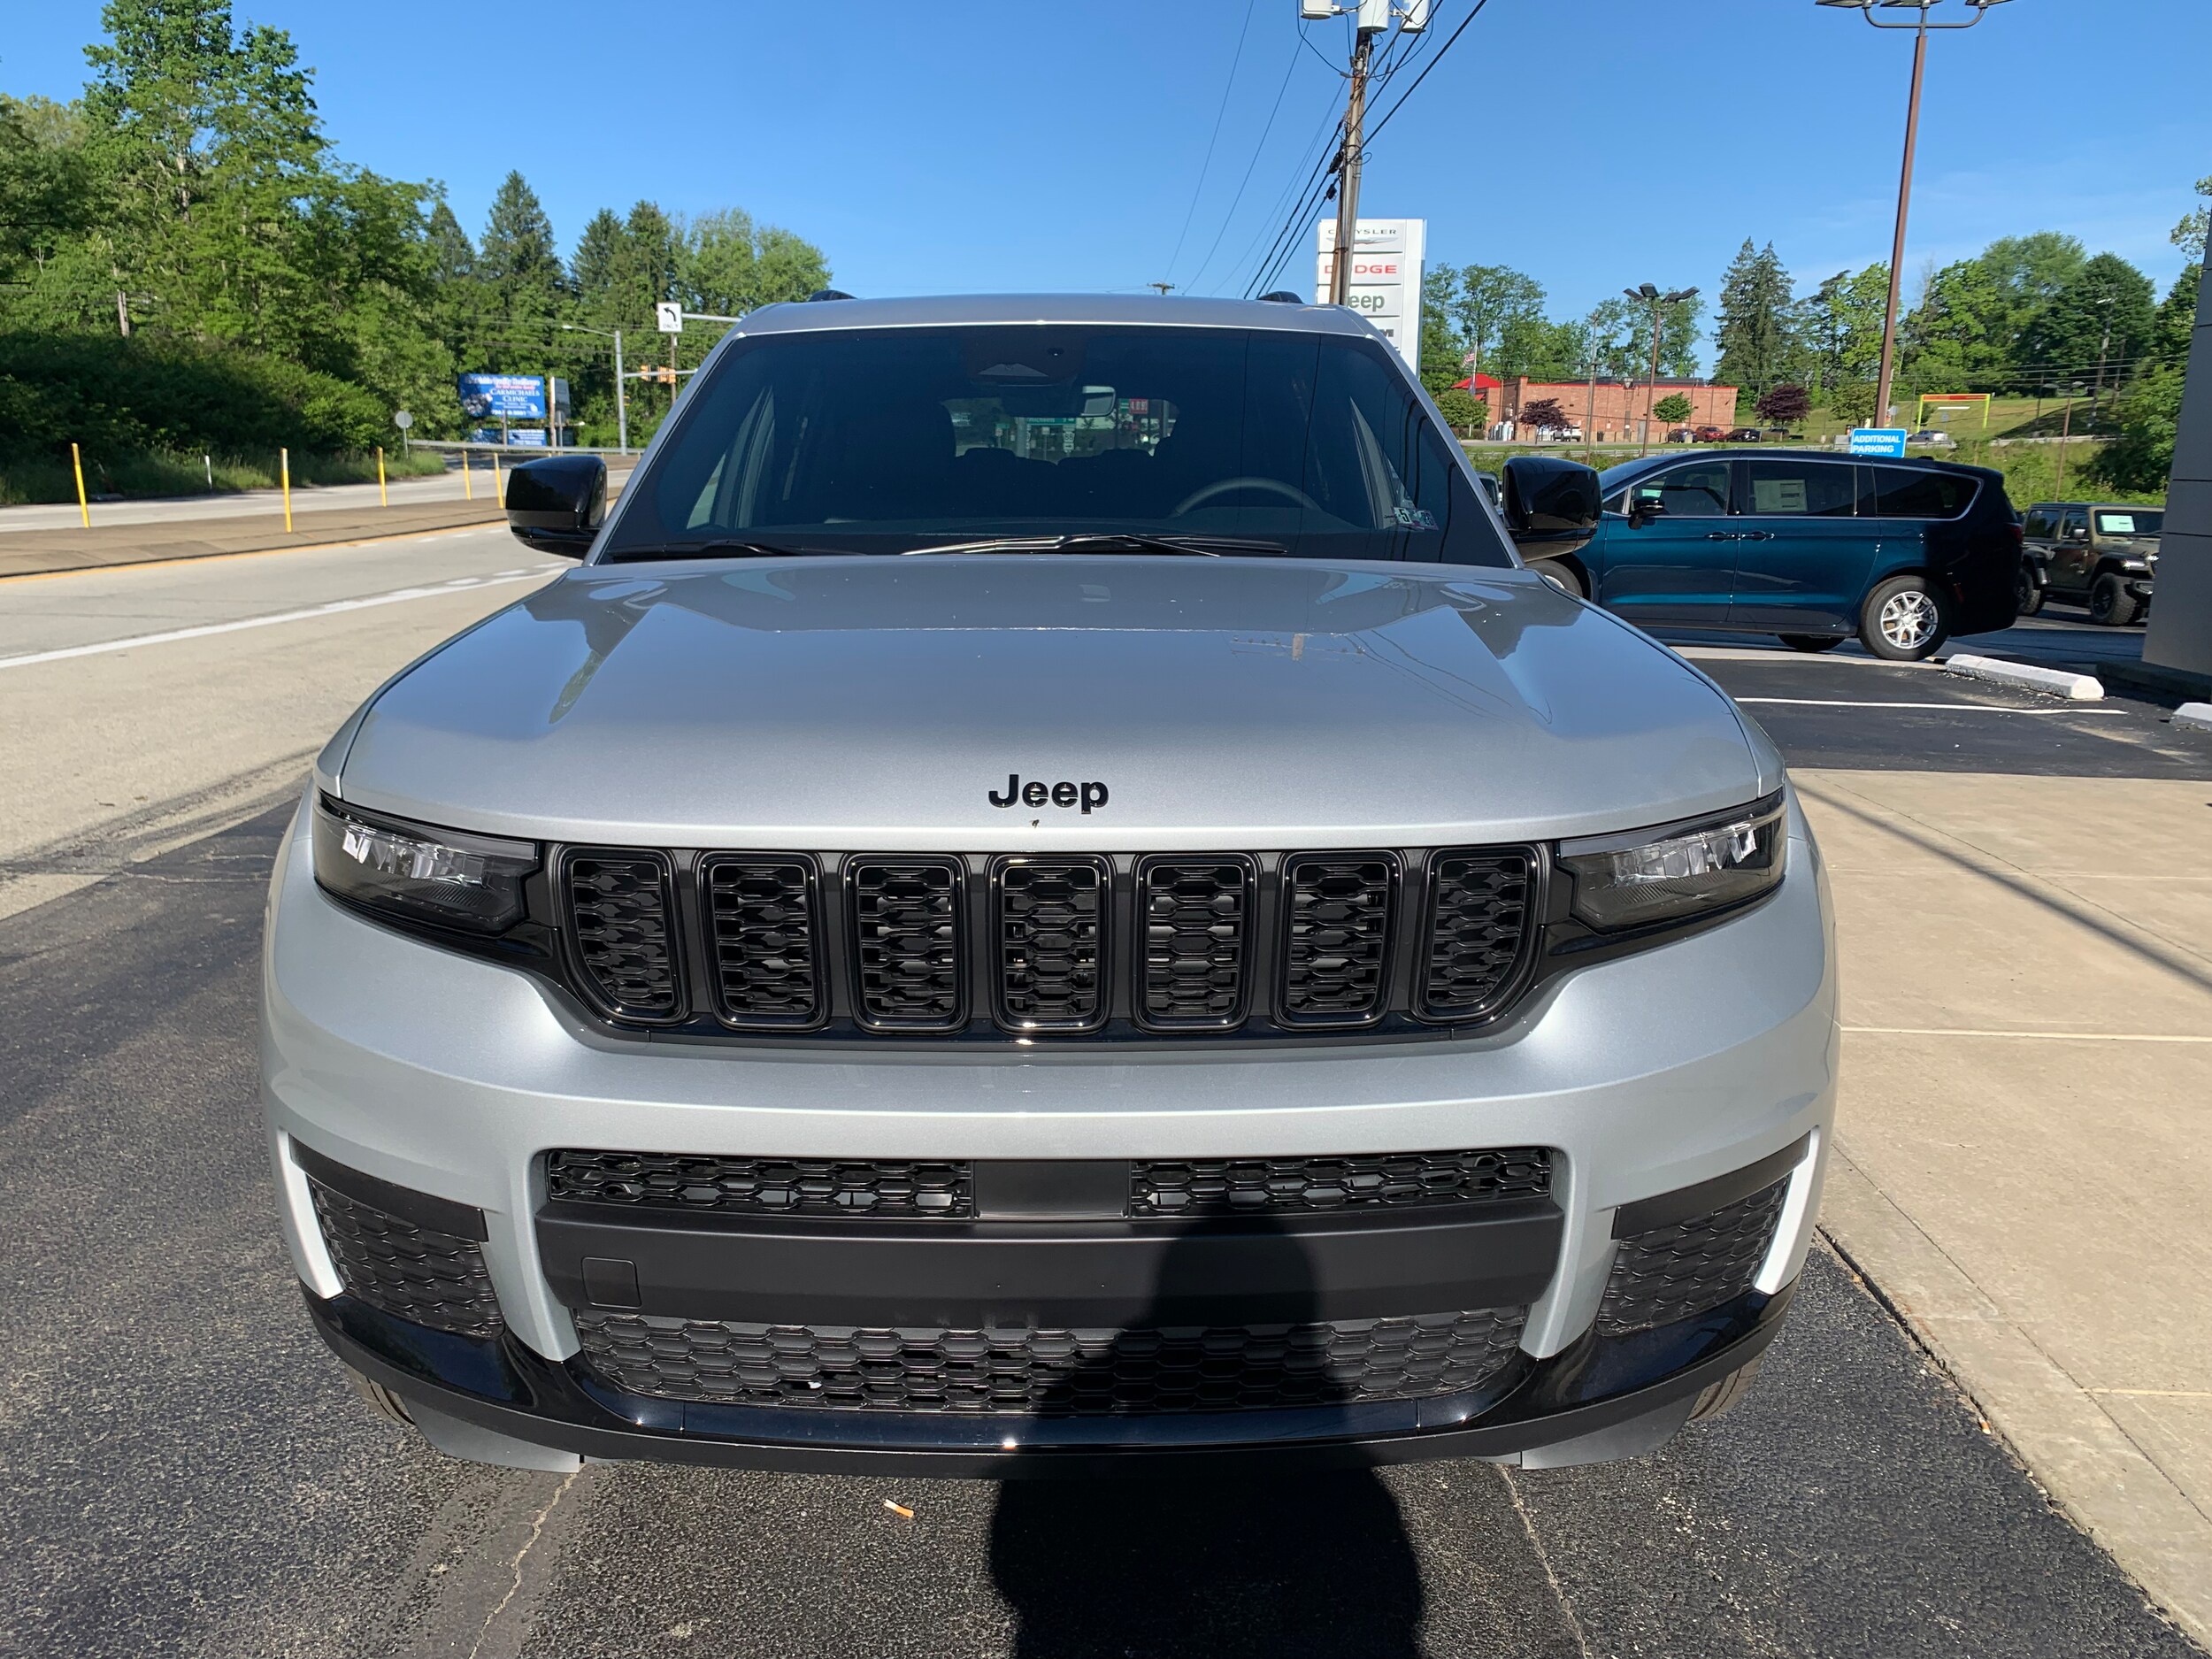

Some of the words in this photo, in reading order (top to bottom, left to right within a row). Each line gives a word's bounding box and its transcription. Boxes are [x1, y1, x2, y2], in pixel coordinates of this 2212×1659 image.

[1325, 265, 1397, 273] DDGE
[1348, 295, 1386, 311] eep
[1854, 434, 1901, 443] ADDITIONAL
[988, 774, 1109, 814] Jeep
